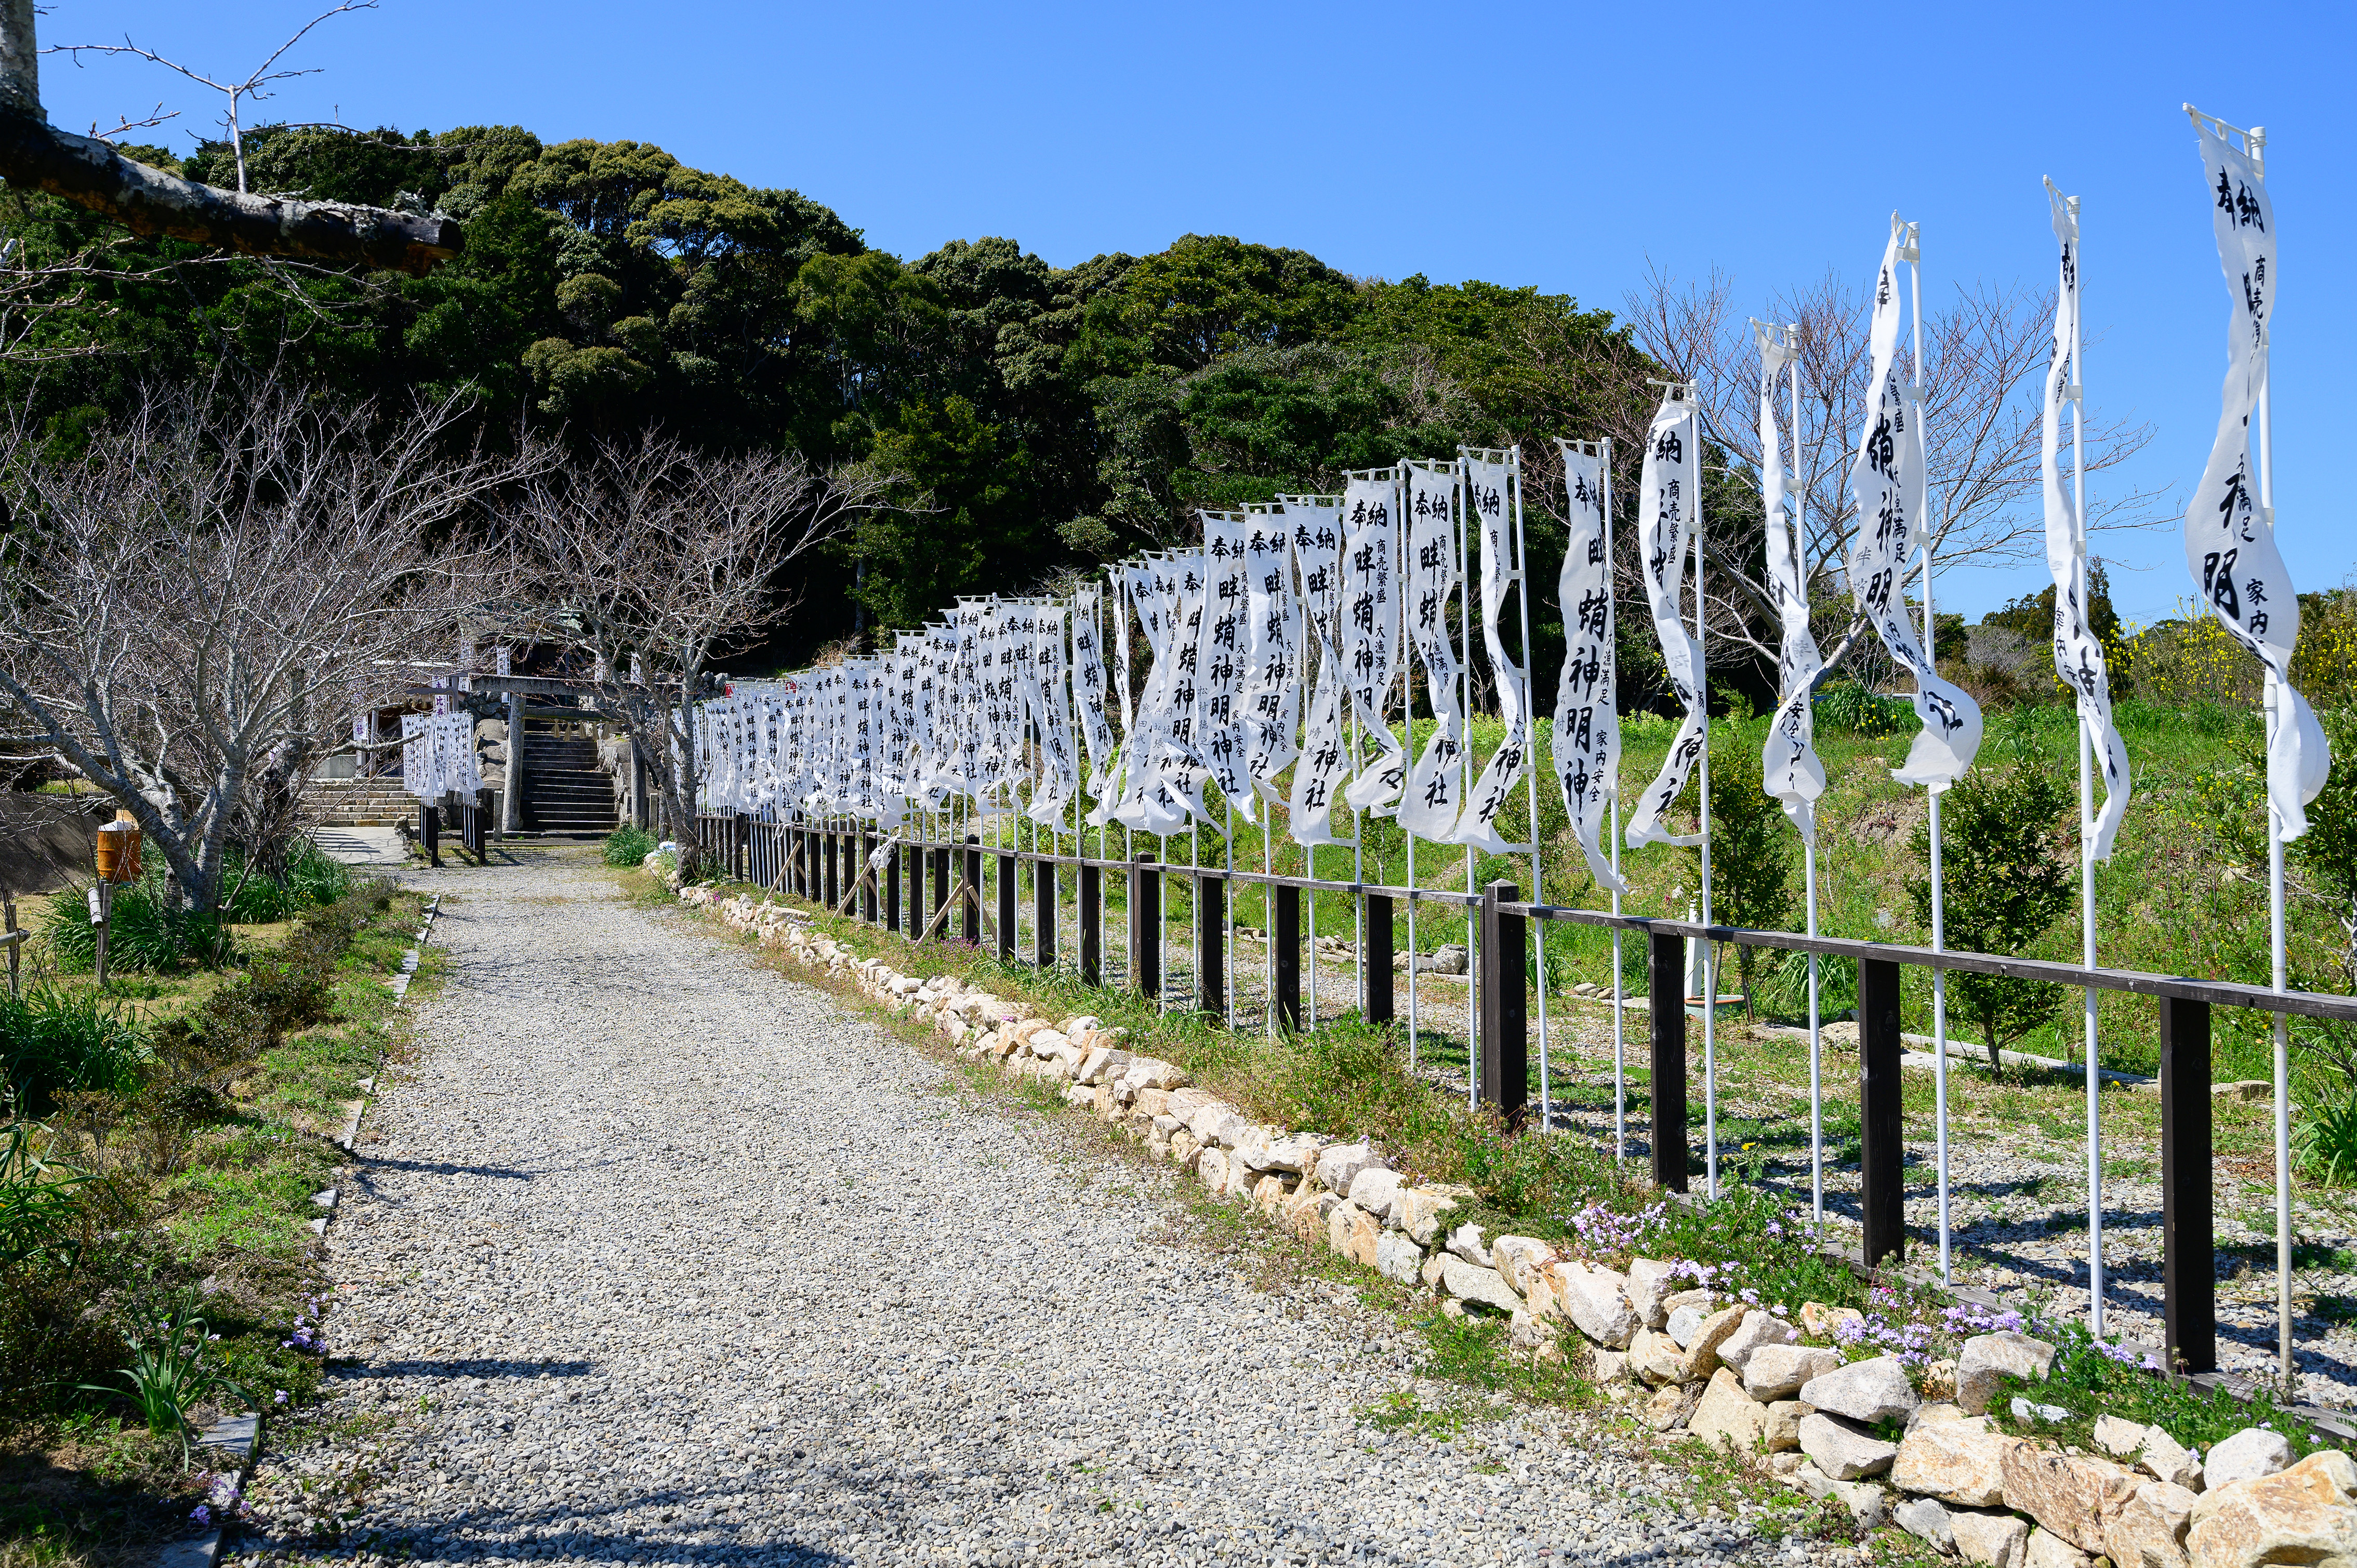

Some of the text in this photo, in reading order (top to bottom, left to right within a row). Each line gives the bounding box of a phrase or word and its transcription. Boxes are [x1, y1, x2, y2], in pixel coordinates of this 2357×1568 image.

[2217, 165, 2265, 233] 奉納
[1878, 265, 1890, 317] 奉
[1350, 499, 1388, 532] 奉納
[1414, 488, 1448, 525] 奉納
[1668, 479, 1681, 564] 商売繁盛
[1210, 535, 1245, 564] 奉納
[1249, 529, 1286, 559] 奉納
[1294, 523, 1335, 555] 奉納
[1184, 571, 1204, 597] 奉
[1439, 534, 1449, 603] 商売繁盛
[1135, 580, 1154, 604] 奉
[960, 611, 978, 629] 奉納
[1007, 615, 1034, 636] 奉納
[1037, 618, 1058, 637] 奉納
[1375, 538, 1388, 686] 商売繁盛 大漁満足
[933, 637, 956, 654] 奉納
[978, 625, 995, 644] 奉納
[997, 621, 1008, 640] 奉
[899, 645, 919, 660] 奉納
[1052, 643, 1060, 685] 商売繁盛
[1232, 570, 1249, 758] 商売繁盛 大漁満足 家内安全
[1283, 639, 1294, 693] 大漁満足
[825, 677, 831, 690] 奉
[834, 674, 845, 687] 奉
[872, 677, 883, 692] 奉
[884, 662, 895, 677] 奉
[1210, 573, 1240, 798] 畔蛸神明神社
[1564, 528, 1609, 826] 畔蛸神明神
[807, 696, 814, 708] 奉
[815, 681, 823, 694] 奉
[1173, 605, 1203, 796] 畔蛸神明神社
[1305, 565, 1339, 813] 畔蛸神社
[730, 706, 737, 716] 奉
[775, 708, 784, 719] 奉
[785, 699, 794, 711] 奉
[962, 635, 977, 782] 畔蛸神明神社
[1053, 697, 1064, 737] 大漁満足
[1589, 629, 1613, 802] 大漁満足 家内安全
[1277, 709, 1289, 753] 家内安全
[1303, 726, 1321, 758] 晴美
[1555, 689, 1566, 773] 村哲
[857, 697, 873, 809] 畔蛸神明神社
[999, 743, 1008, 776] 家内安全
